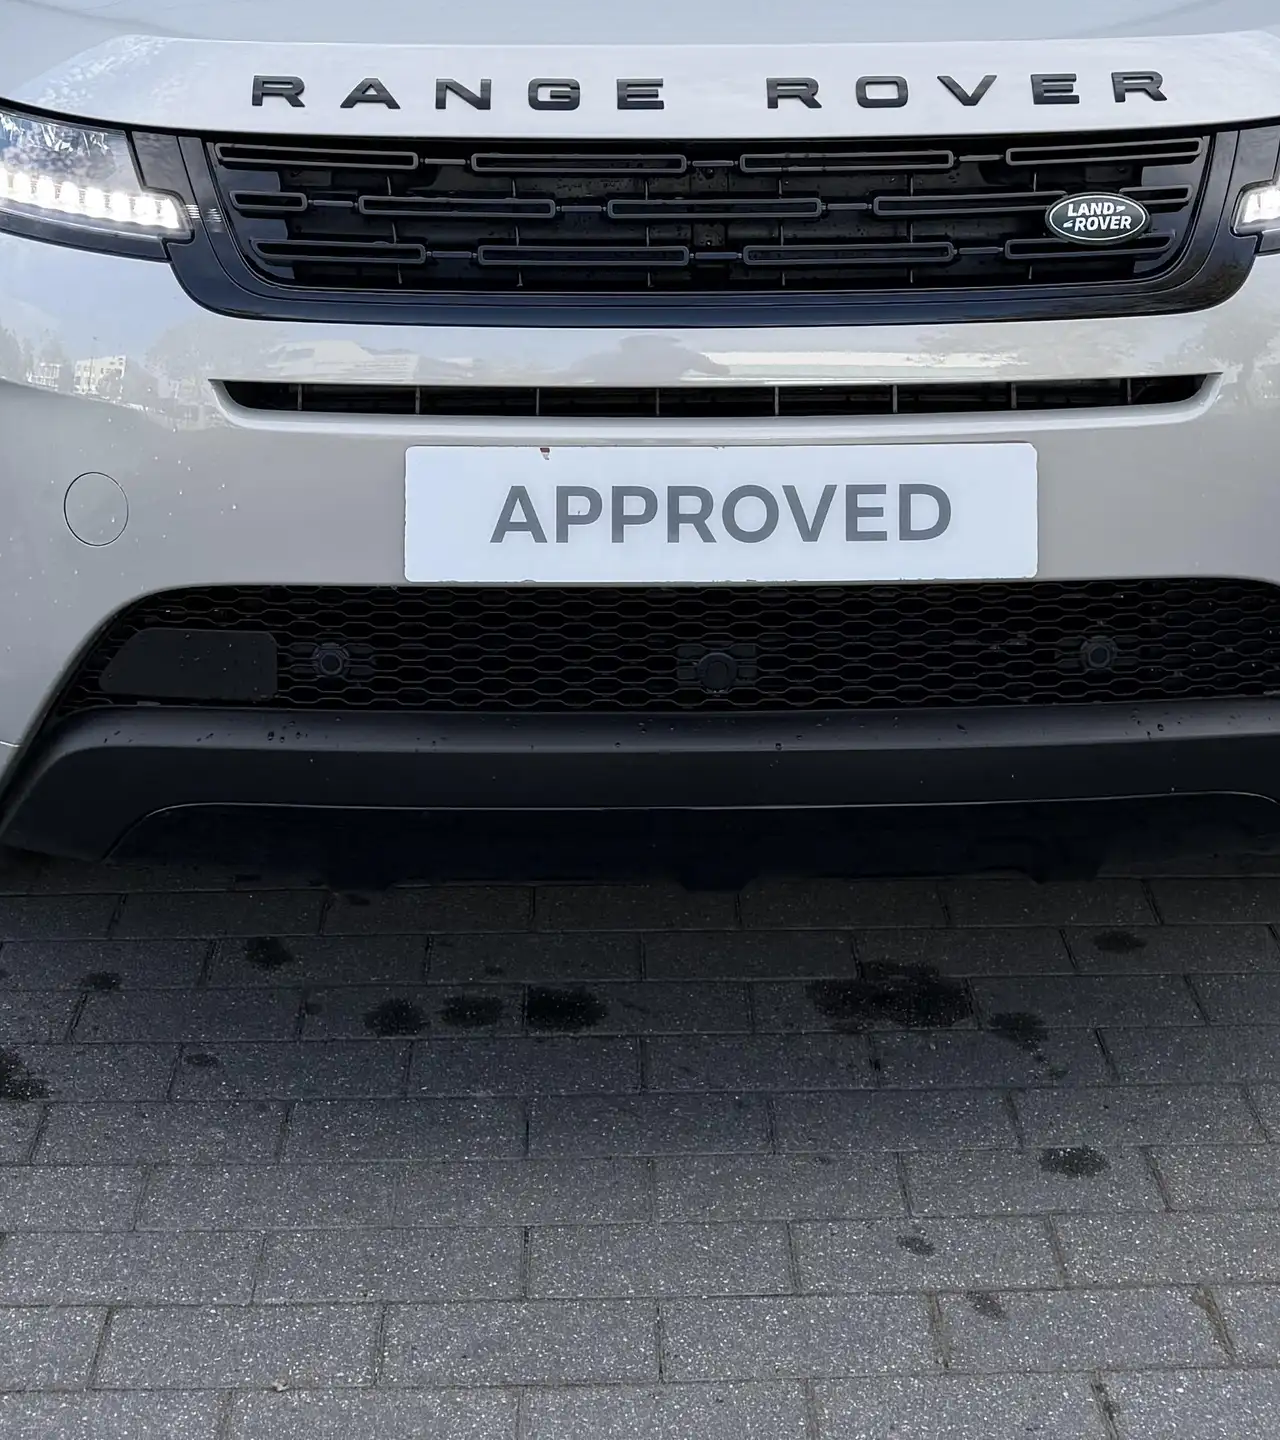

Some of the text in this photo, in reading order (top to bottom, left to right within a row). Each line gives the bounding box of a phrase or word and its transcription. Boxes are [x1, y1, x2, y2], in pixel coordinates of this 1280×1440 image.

[251, 70, 1168, 111] RANGE ROVER
[1067, 202, 1115, 217] LAND
[1074, 215, 1132, 232] ROVER
[490, 483, 952, 544] APPROVED
